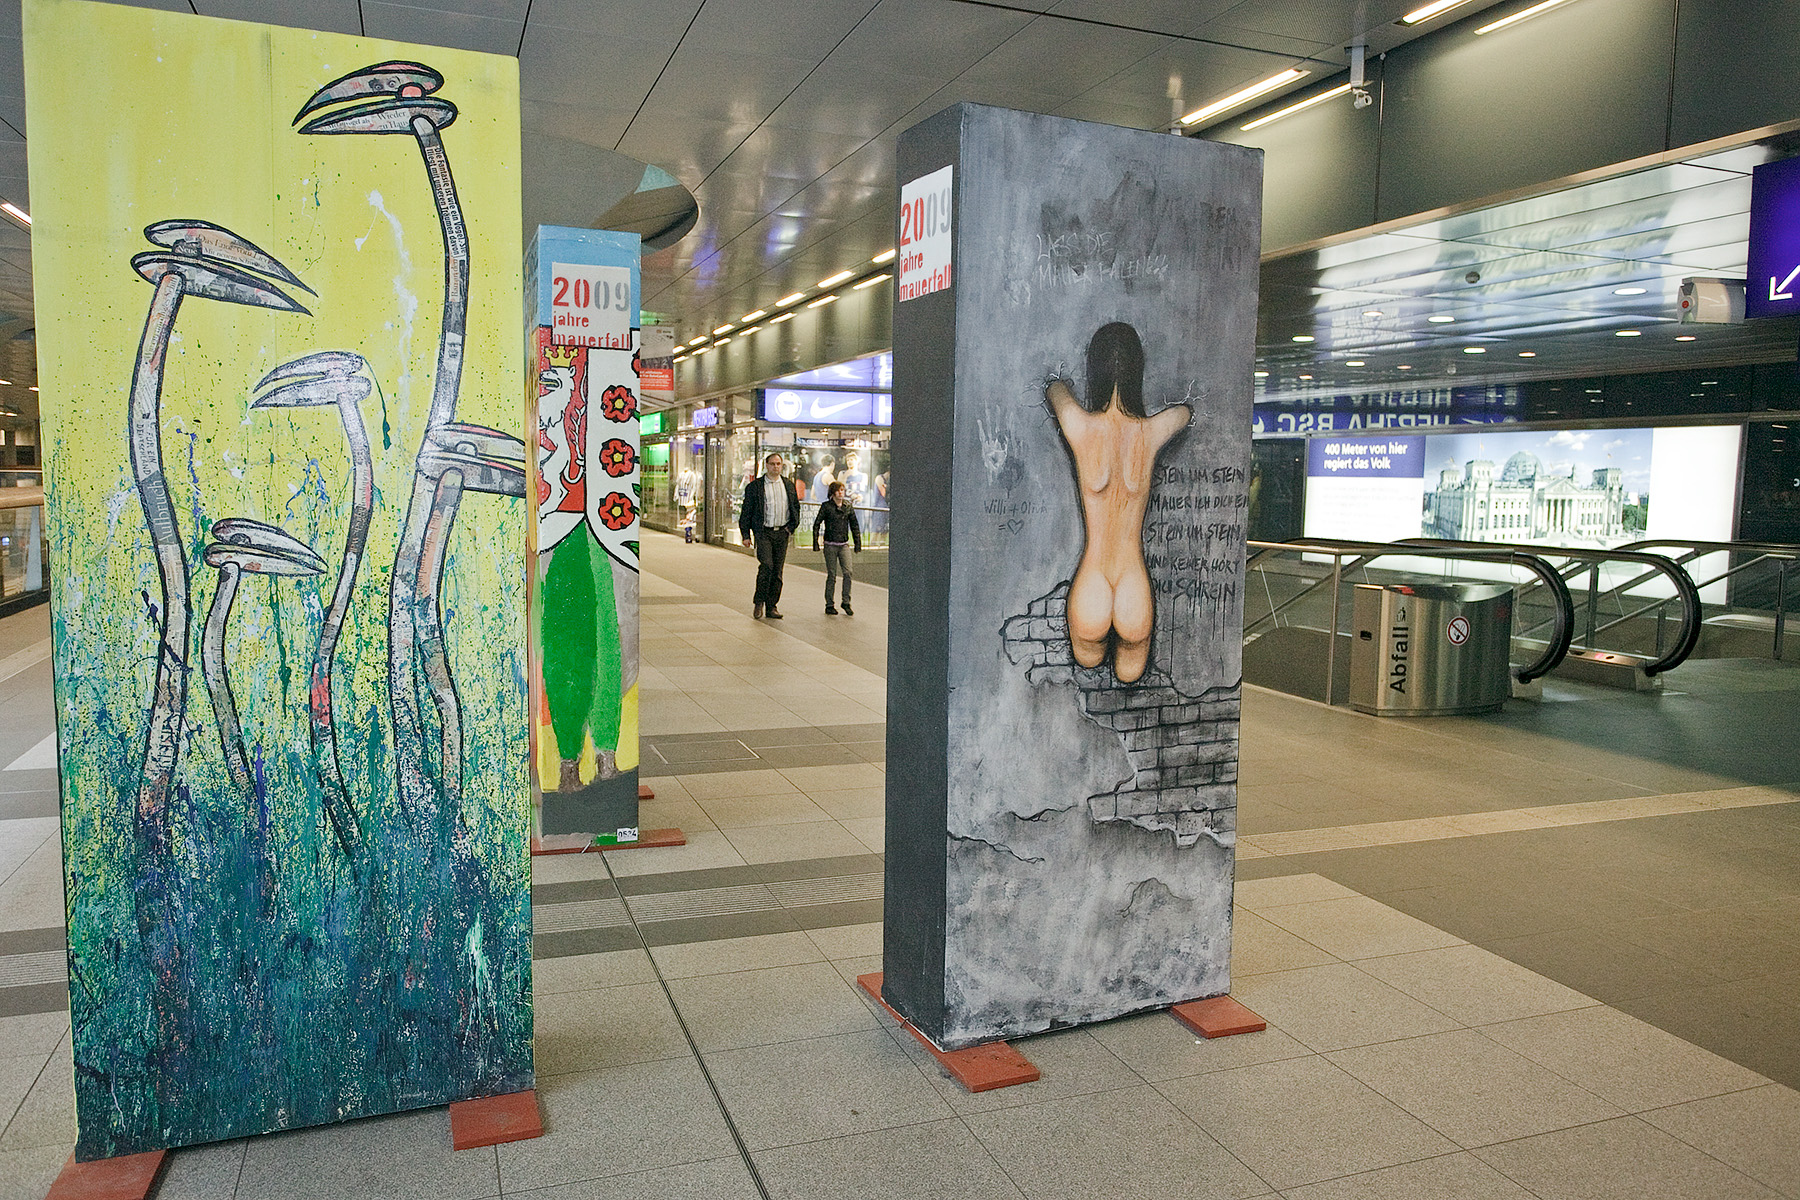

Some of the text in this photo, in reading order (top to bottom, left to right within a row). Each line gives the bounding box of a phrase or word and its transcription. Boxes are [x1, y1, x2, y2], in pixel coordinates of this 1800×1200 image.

[438, 160, 450, 188] Fantasie
[435, 180, 446, 205] unseren
[447, 197, 456, 209] wie
[451, 210, 459, 221] ein
[900, 187, 951, 247] 2009
[900, 250, 923, 279] jahre
[899, 263, 952, 301] mauerfall
[553, 276, 630, 312] 2009
[553, 310, 590, 328] jahre
[553, 332, 630, 348] mauerfall
[1324, 441, 1408, 456] 400 Meter von hier
[1211, 466, 1245, 484] STEIN
[1323, 456, 1391, 472] regiert das Volk
[147, 480, 175, 545] Aufbruch
[983, 499, 1006, 515] Willi
[1149, 493, 1192, 513] MAUER
[1194, 495, 1211, 509] ICH
[1207, 522, 1241, 546] STEIN
[1389, 627, 1408, 694] Abfall
